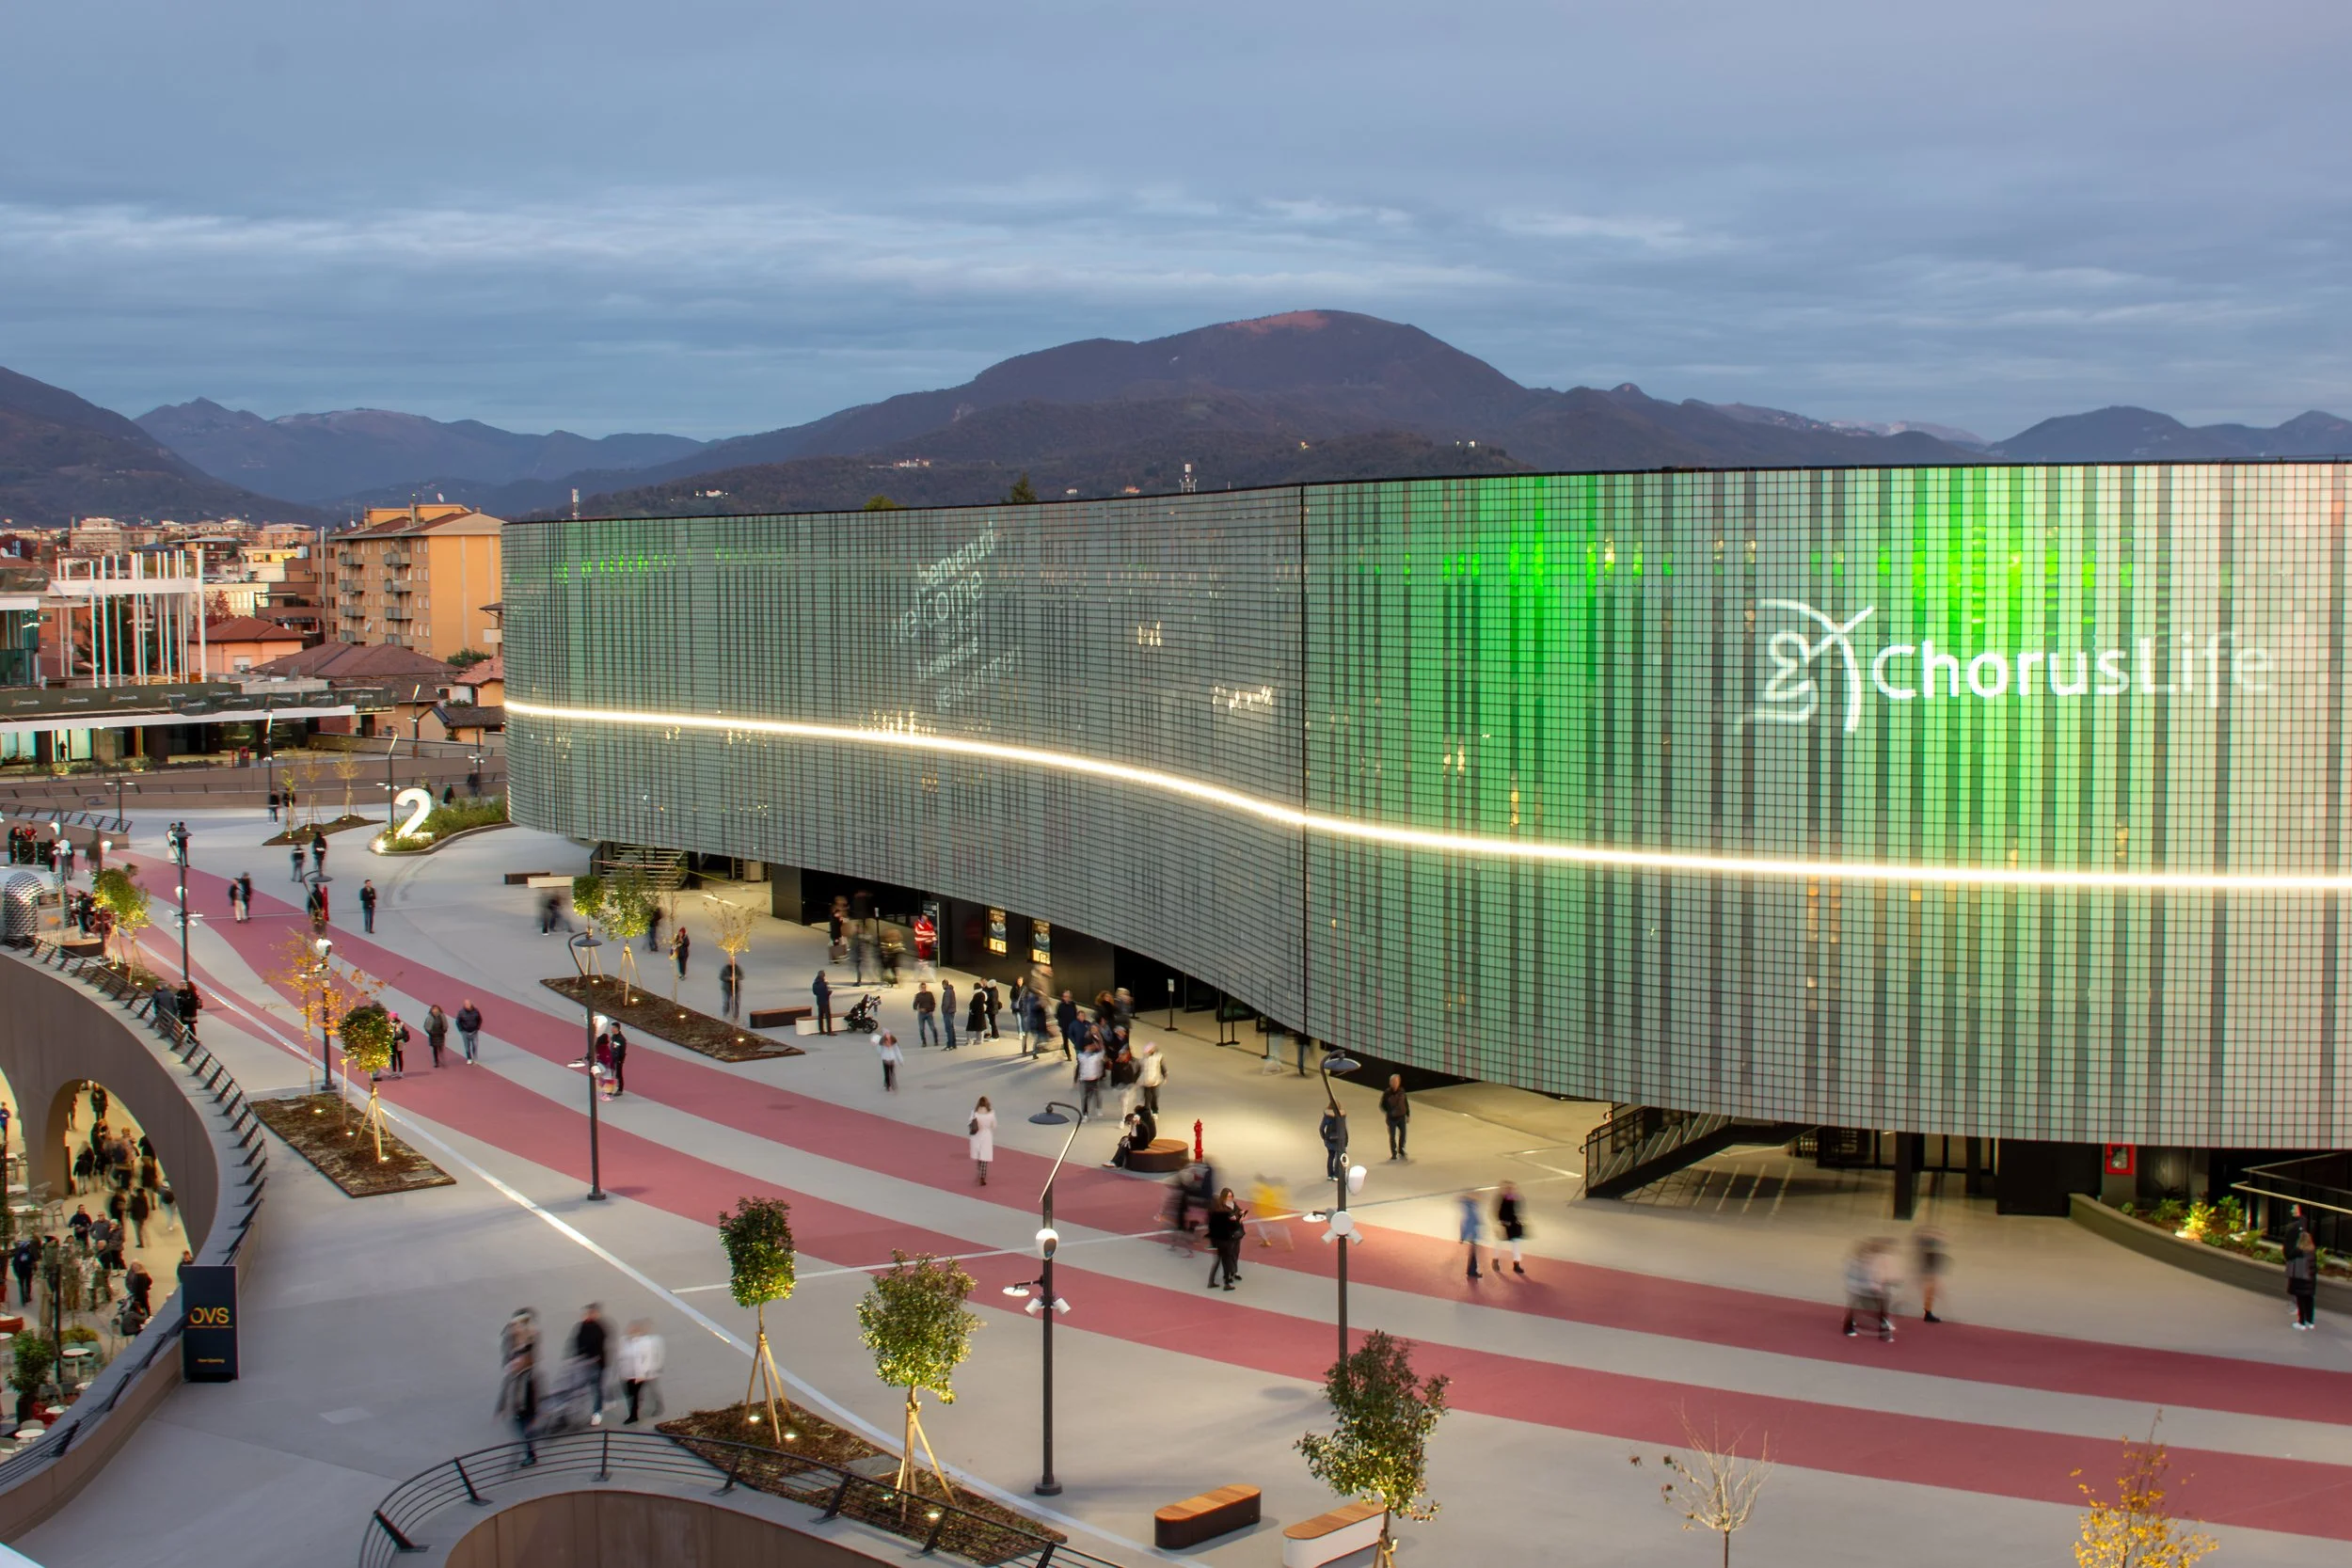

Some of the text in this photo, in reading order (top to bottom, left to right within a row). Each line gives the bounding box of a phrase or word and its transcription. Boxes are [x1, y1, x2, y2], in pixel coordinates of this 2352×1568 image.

[916, 520, 995, 587] benvenuti
[887, 571, 982, 650] welcome
[1872, 630, 2273, 709] ChorusLife
[394, 787, 435, 844] 2
[190, 1307, 230, 1324] OVS
